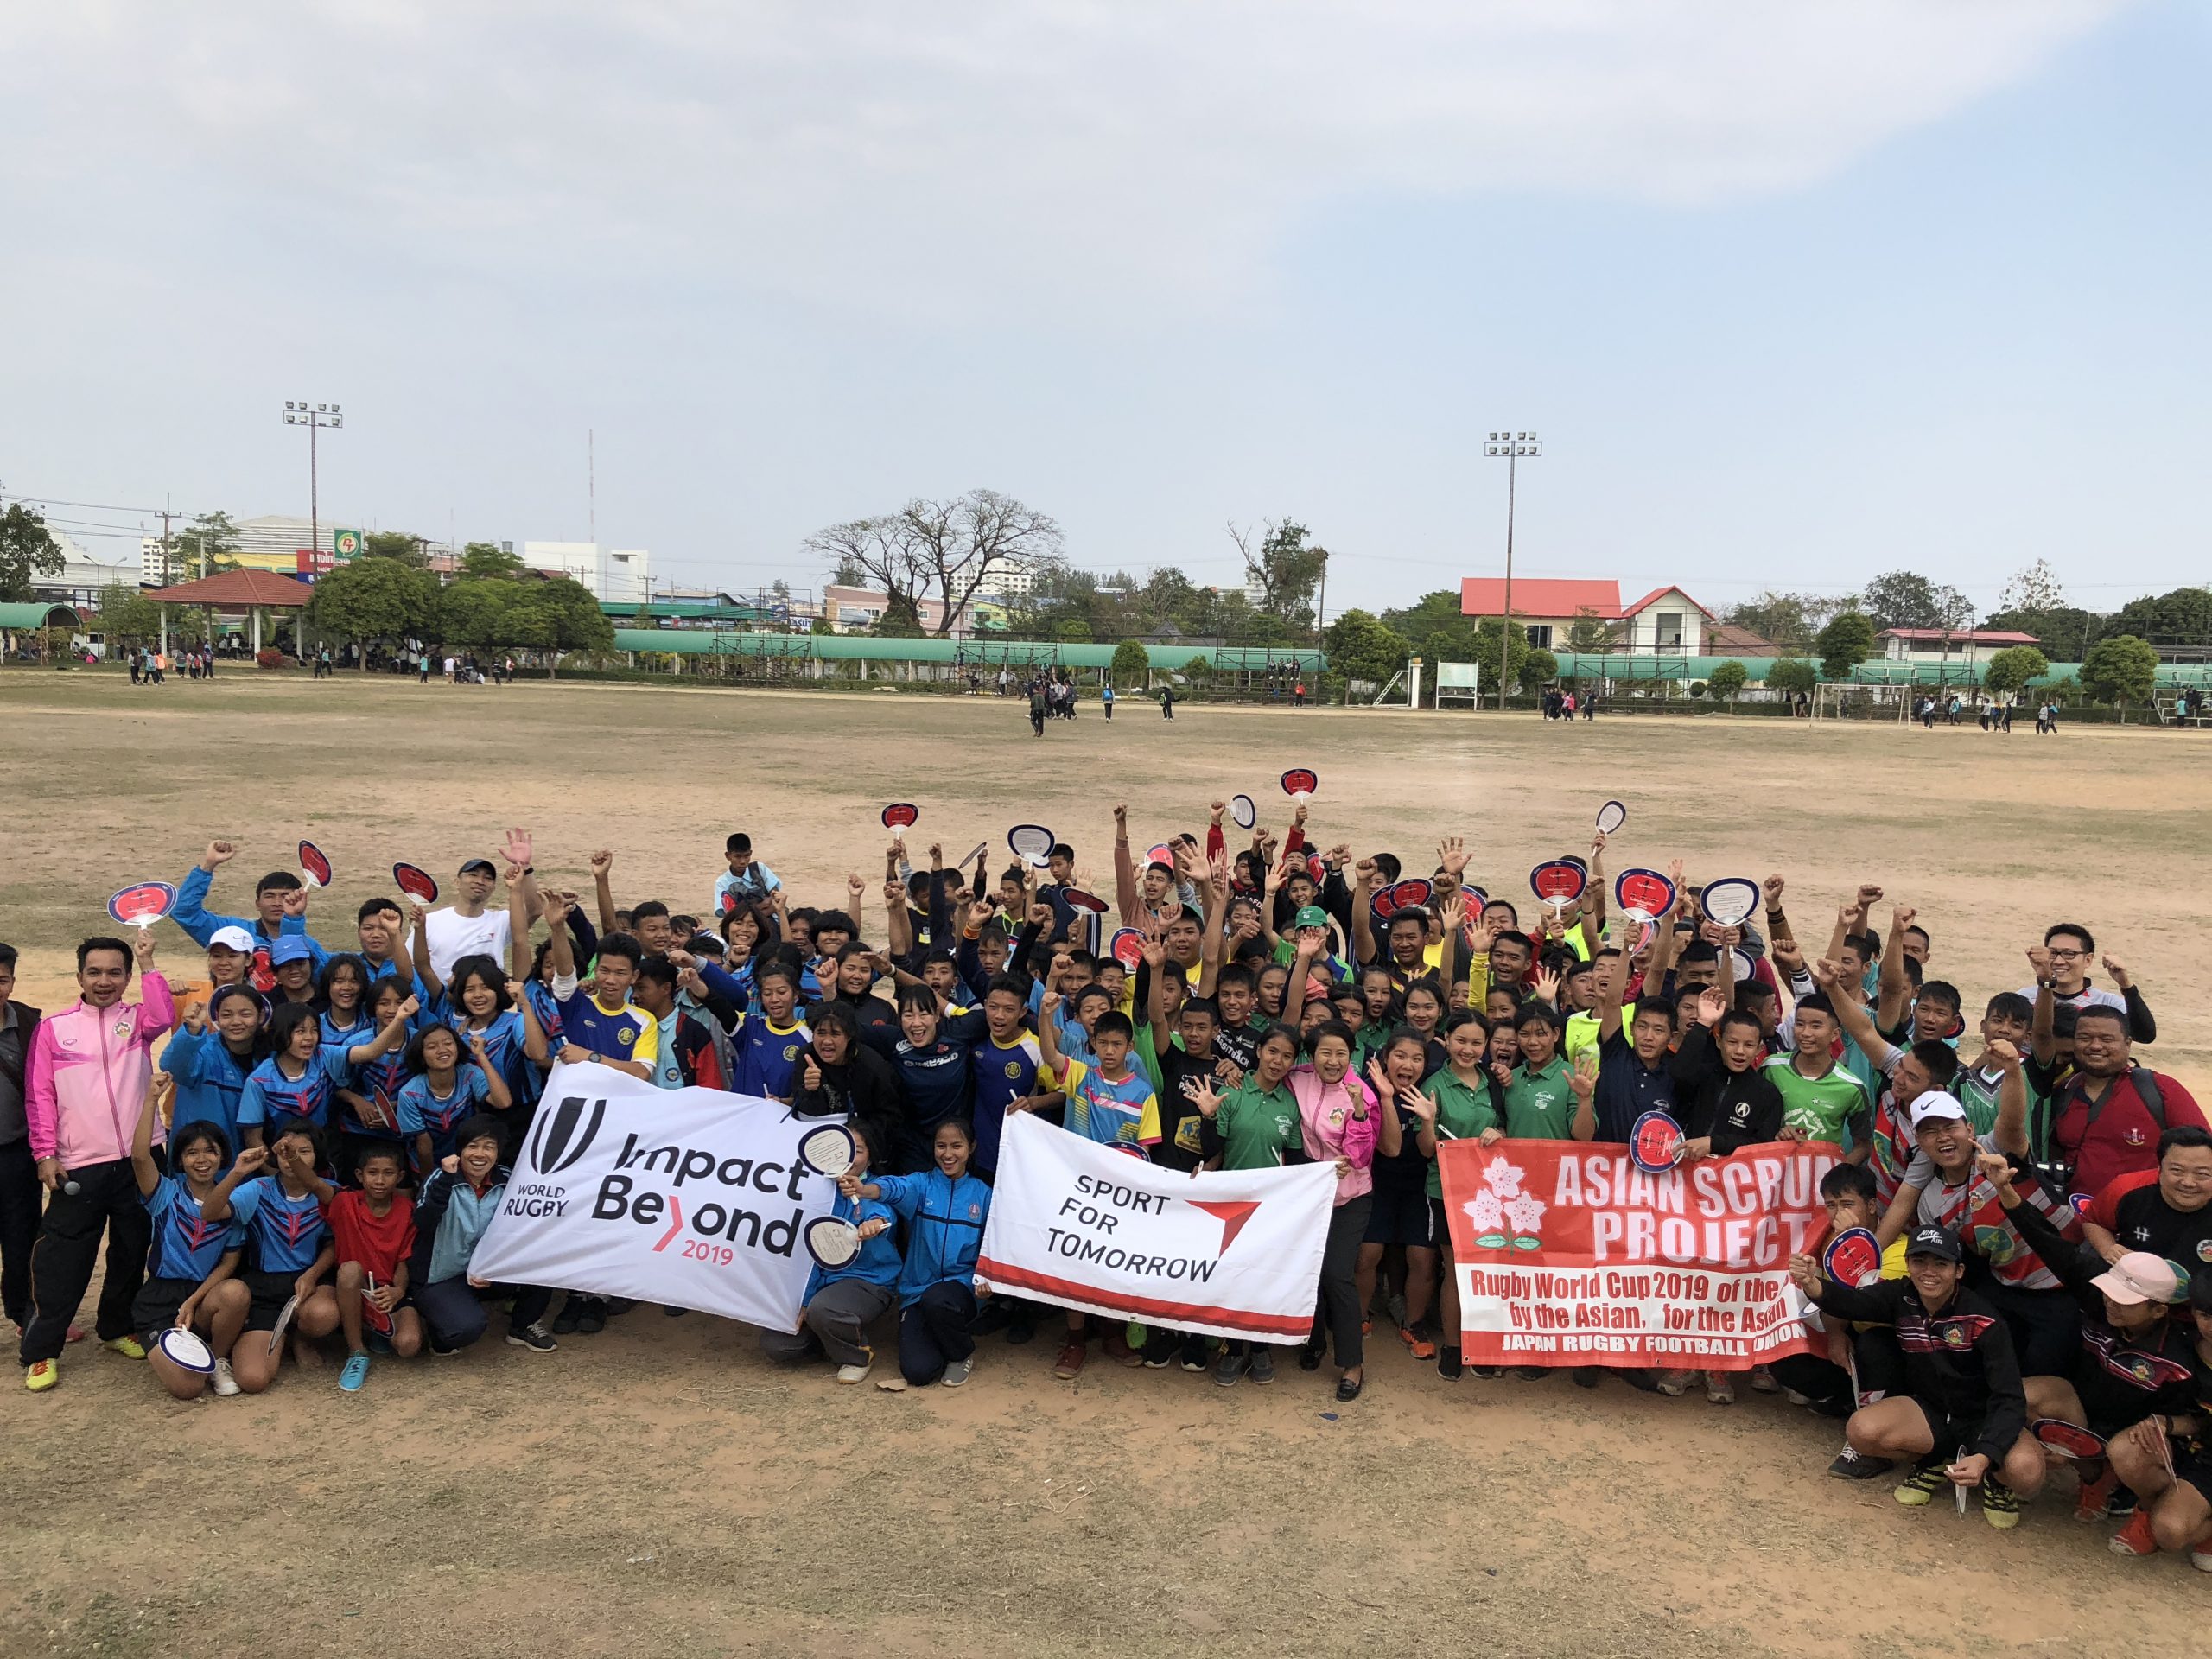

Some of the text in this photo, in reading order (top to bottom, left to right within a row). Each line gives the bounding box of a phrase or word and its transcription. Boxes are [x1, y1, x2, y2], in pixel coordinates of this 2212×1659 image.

[342, 538, 354, 551] PT
[613, 1133, 810, 1201] Impact
[1554, 1155, 1684, 1215] ASIAN
[503, 1198, 569, 1217] RUGBY
[518, 1184, 566, 1198] WORLD
[1074, 1174, 1171, 1216] SPORT
[591, 1174, 804, 1258] Beyond
[1058, 1197, 1118, 1236] FOR
[681, 1239, 734, 1266] 2019
[1048, 1227, 1218, 1283] TOMORROW
[1592, 1211, 1812, 1268] PROJECT
[1471, 1269, 1531, 1300] Rugby
[1534, 1271, 1601, 1299] World
[1606, 1271, 1650, 1300] Cup
[1653, 1271, 1709, 1301] 2019
[1716, 1278, 1741, 1303] of
[1744, 1277, 1779, 1302] the
[1509, 1301, 1533, 1330] by
[1534, 1303, 1570, 1329] the
[1575, 1302, 1646, 1330] Asian,
[1662, 1303, 1694, 1331] for
[1697, 1306, 1736, 1332] the
[1502, 1322, 1808, 1357] JAPAN RUGBY FOOTBALL UNION
